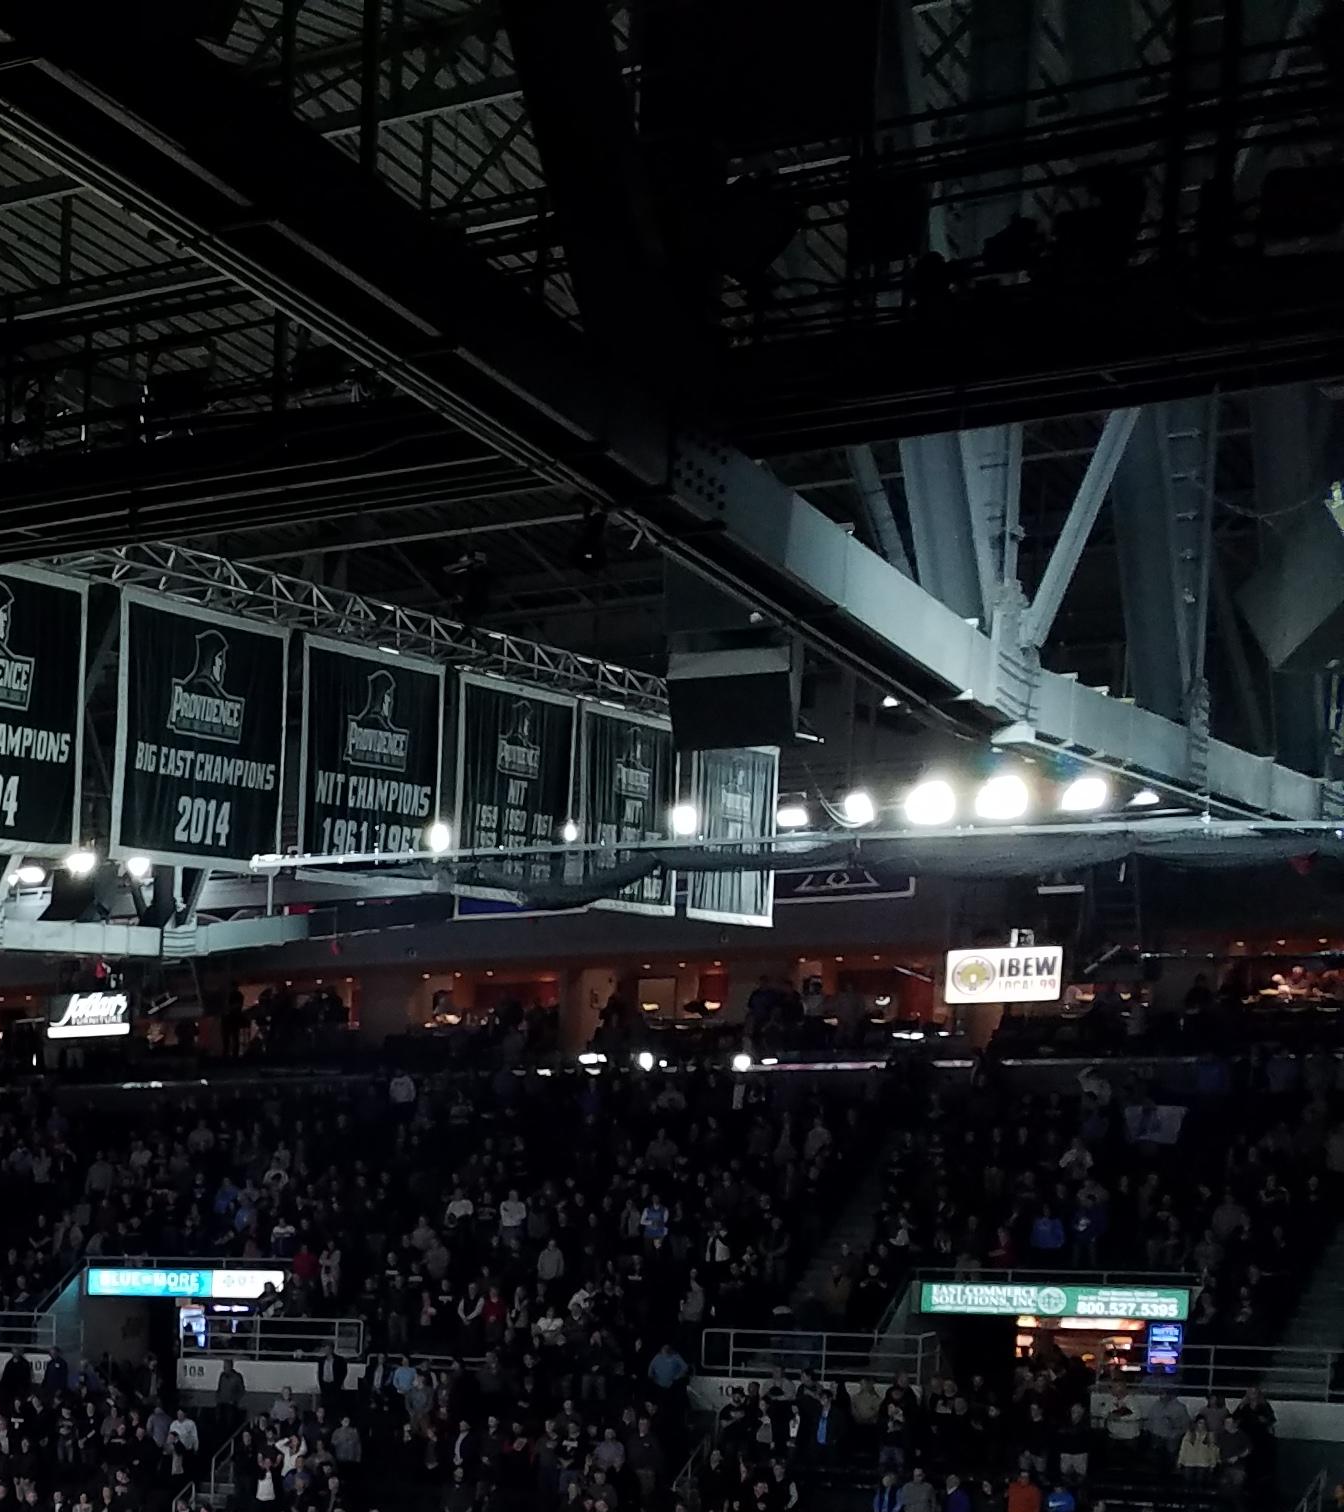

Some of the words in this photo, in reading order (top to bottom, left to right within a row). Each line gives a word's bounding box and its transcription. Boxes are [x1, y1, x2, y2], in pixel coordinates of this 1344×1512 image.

[172, 686, 241, 727] PROVIDENCE
[348, 721, 406, 757] PROVIDENCE
[135, 741, 158, 772] BIG
[159, 747, 195, 779] EAST
[195, 753, 276, 790] CHAMPIONS
[315, 770, 345, 805] NIT
[347, 775, 431, 817] CHAMPIONS
[174, 796, 231, 847] 2014
[999, 956, 1057, 977] IBEW
[932, 1285, 964, 1297] EAST
[965, 1286, 1038, 1297] COMMERCE
